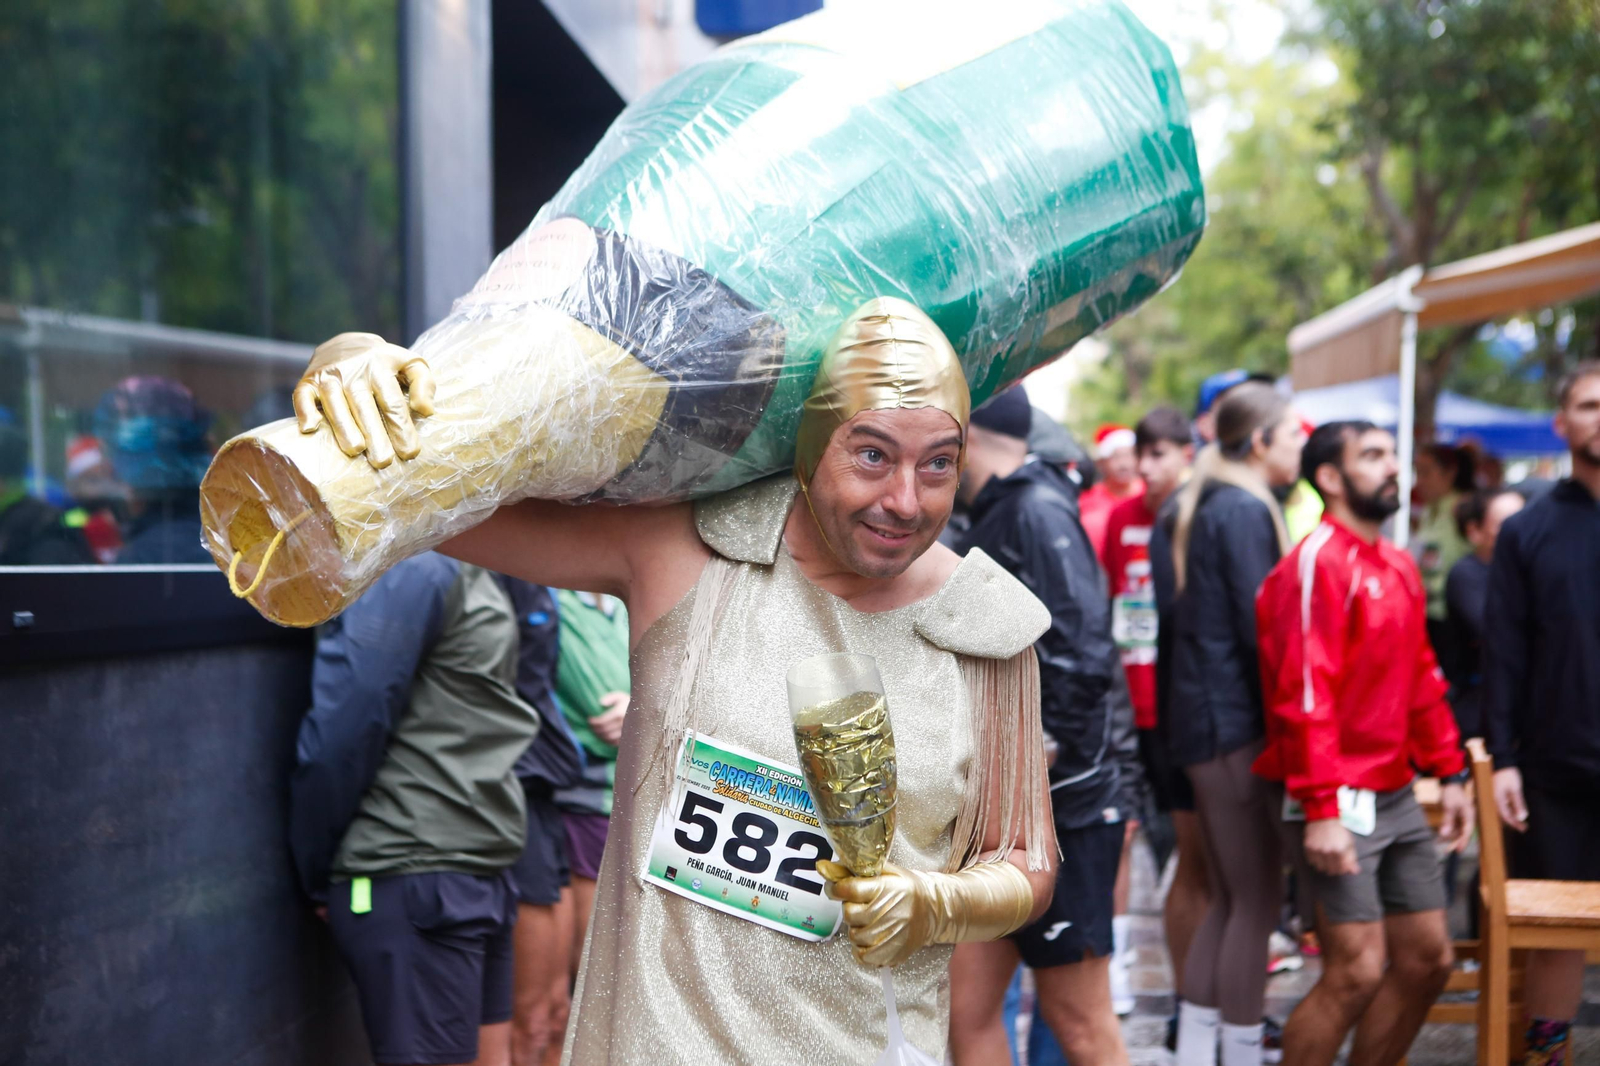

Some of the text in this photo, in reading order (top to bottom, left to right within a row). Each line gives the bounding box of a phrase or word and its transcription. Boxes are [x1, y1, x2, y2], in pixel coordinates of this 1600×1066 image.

[709, 761, 771, 800] CARRERA
[773, 784, 817, 817] NAVID
[712, 780, 749, 804] Solidaria
[749, 798, 773, 811] CIUDAD
[773, 806, 783, 815] DE
[755, 765, 803, 787] XII EDICIÓN
[673, 790, 834, 896] 582
[686, 857, 790, 902] PEÑA GARCÍA, JUAN MANUEL
